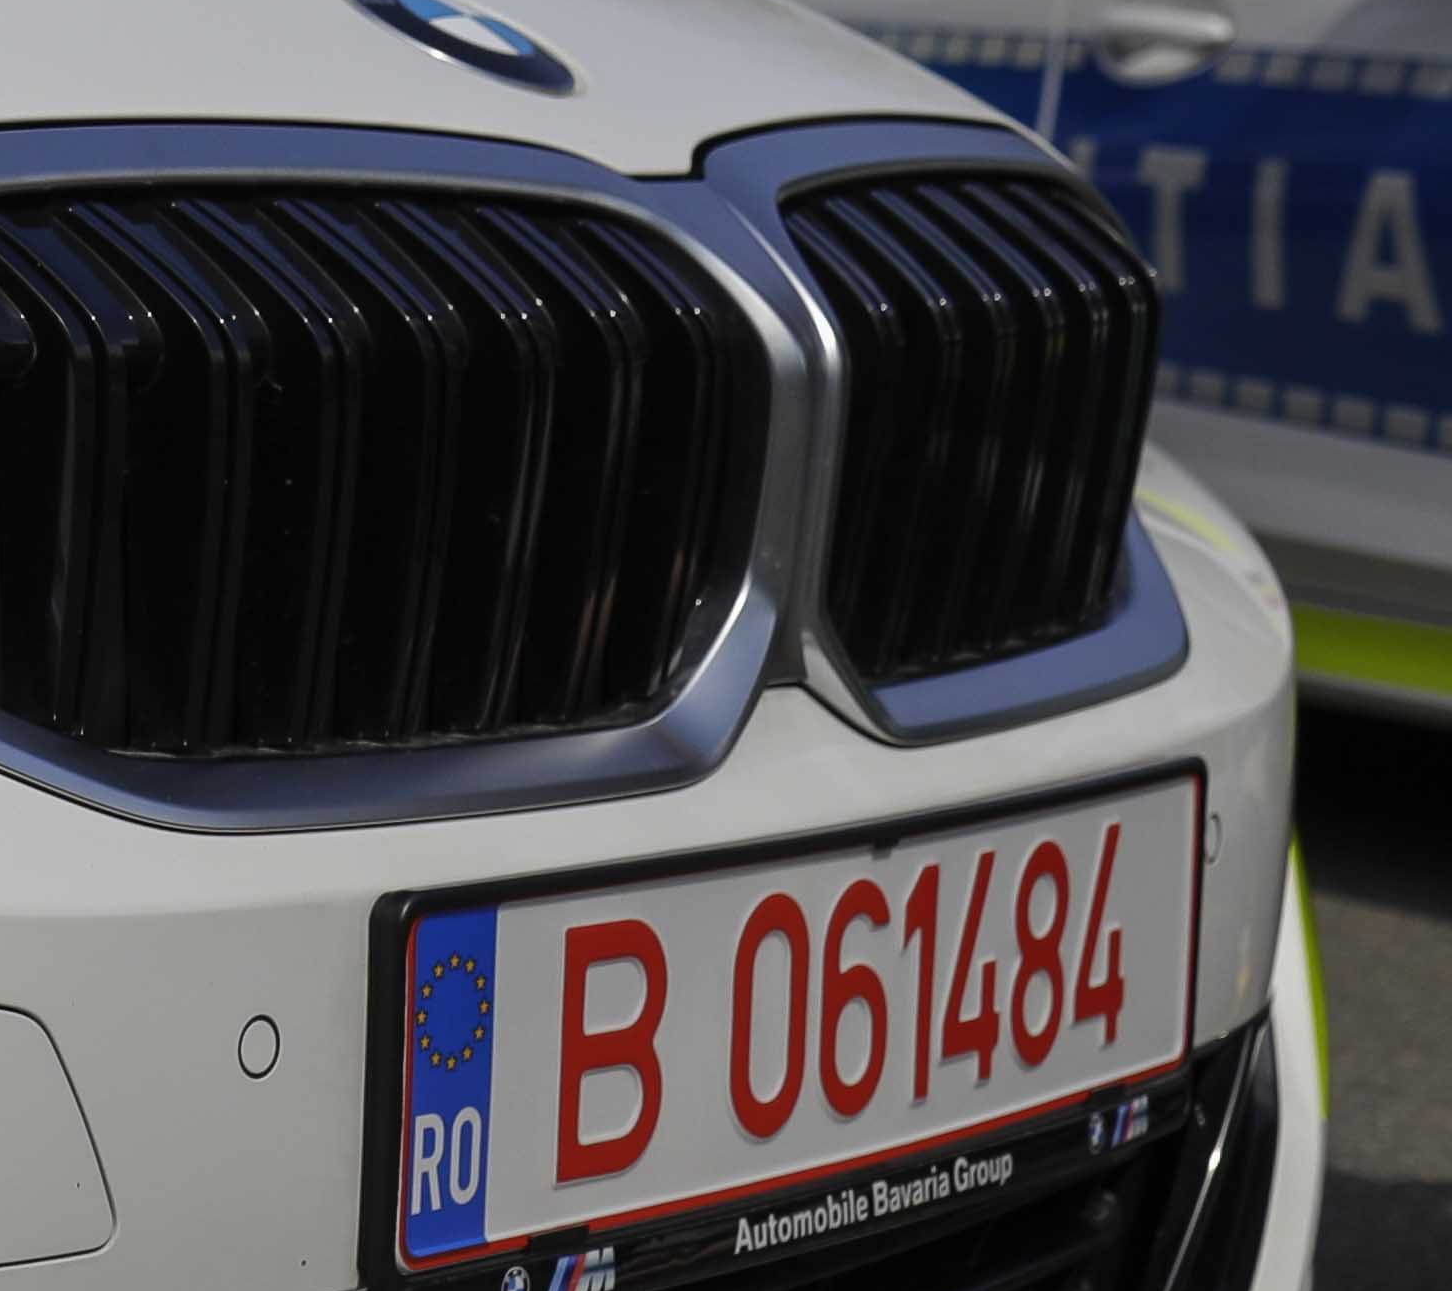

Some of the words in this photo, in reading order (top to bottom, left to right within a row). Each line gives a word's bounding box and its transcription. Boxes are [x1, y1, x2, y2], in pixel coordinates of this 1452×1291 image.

[556, 919, 668, 1184] B
[729, 822, 1125, 1139] 061484
[410, 1106, 483, 1217] RO
[734, 1190, 868, 1254] Automobile
[872, 1167, 951, 1216] Bavaria
[954, 1152, 1014, 1191] Group
